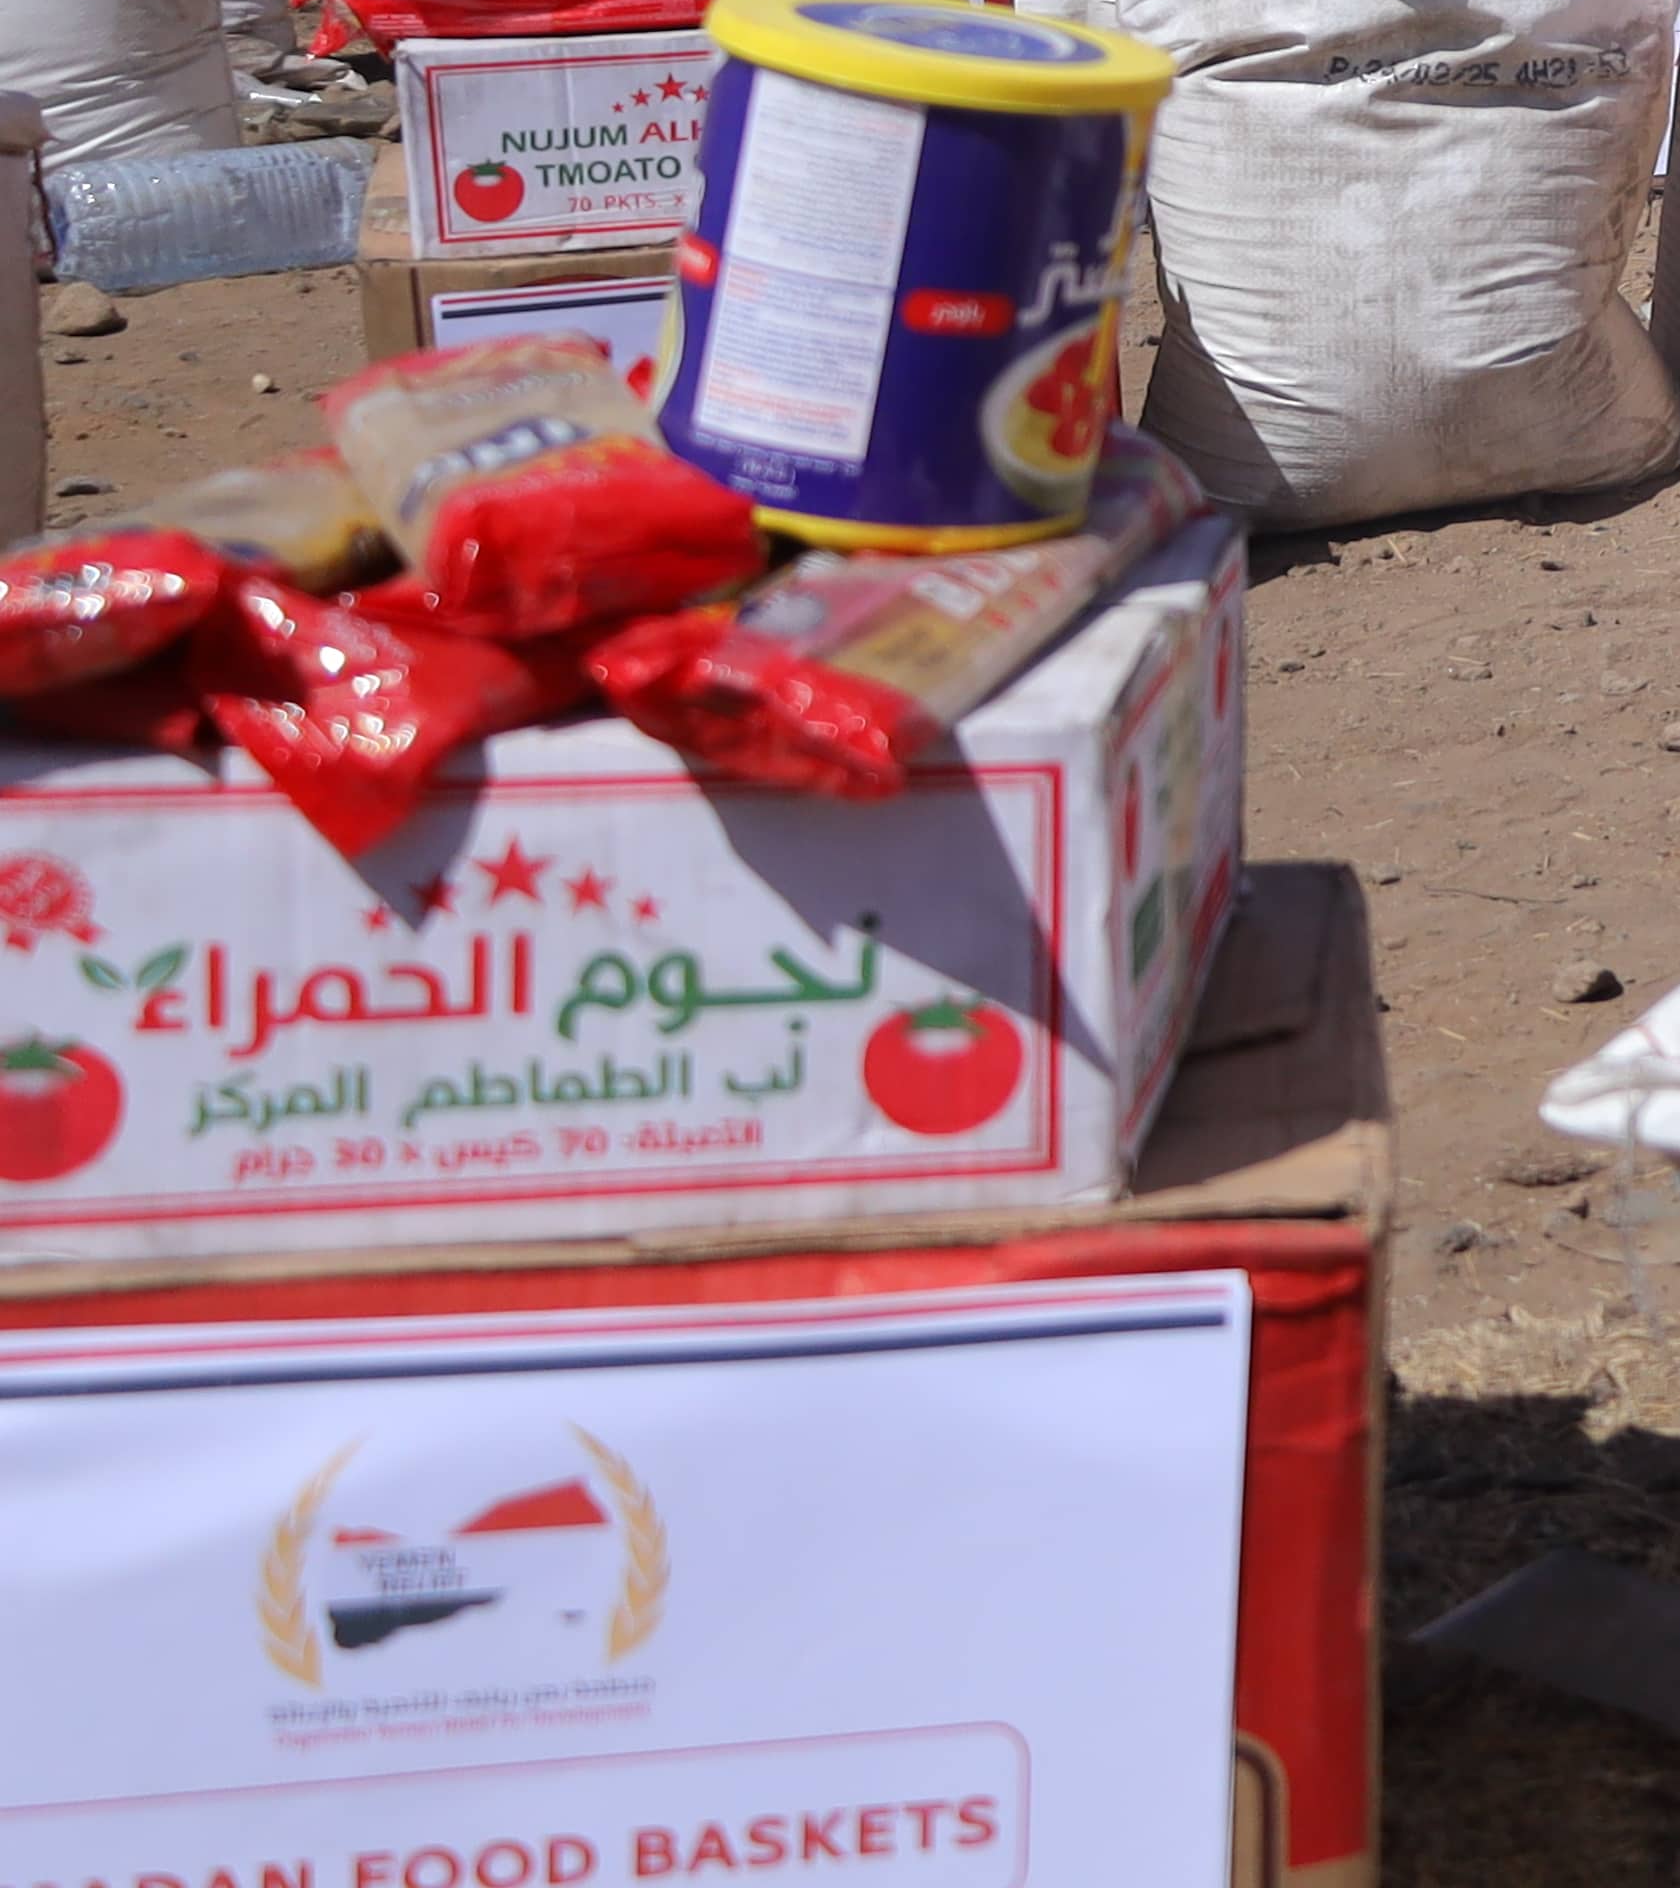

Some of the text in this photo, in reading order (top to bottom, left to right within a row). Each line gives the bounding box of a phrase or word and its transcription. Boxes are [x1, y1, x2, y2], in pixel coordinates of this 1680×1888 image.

[502, 124, 627, 153] NUJUM
[535, 155, 682, 187] TMOATO
[134, 912, 882, 1063] نجوم الحمراء
[188, 1065, 371, 1136] المركز
[403, 1048, 692, 1130] الطماطم
[631, 1795, 998, 1880] BASKETS
